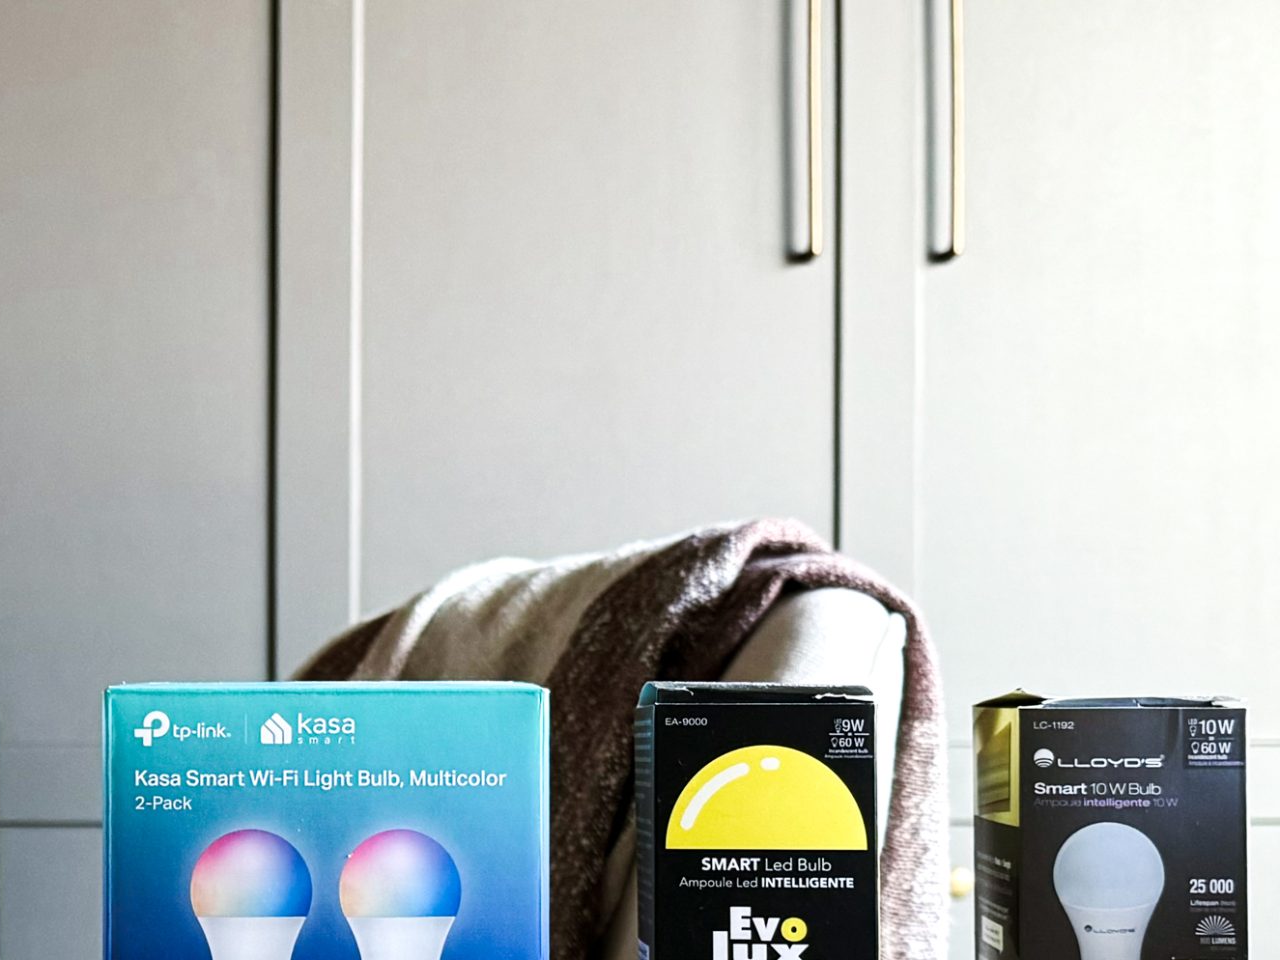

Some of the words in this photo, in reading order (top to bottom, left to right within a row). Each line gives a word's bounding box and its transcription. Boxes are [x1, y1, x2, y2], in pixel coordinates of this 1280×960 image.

[298, 713, 356, 734] kasa
[665, 718, 708, 726] EA-9000
[842, 719, 865, 732] 9W
[1033, 721, 1074, 729] LC-1192
[1199, 720, 1217, 734] 10
[1218, 720, 1234, 734] W
[298, 736, 356, 744] smart
[839, 738, 852, 748] 60
[854, 738, 865, 747] W
[1201, 742, 1216, 753] 60
[1219, 742, 1231, 753] W
[1057, 758, 1162, 768] LLOYD'S
[135, 770, 181, 787] Kasa
[186, 769, 245, 787] Smart
[249, 769, 299, 787] Wi-Fi
[304, 769, 353, 790] Light
[358, 770, 404, 788] Bulb,
[410, 770, 507, 787] Multicolor
[1034, 782, 1087, 795] Smart
[1090, 783, 1107, 795] 10
[1109, 783, 1126, 795] W
[1129, 783, 1161, 795] Bulb
[135, 796, 192, 811] 2-Pack
[1084, 798, 1150, 808] intelligente
[701, 857, 760, 871] SMART
[765, 858, 792, 871] Led
[798, 858, 832, 871] Bulb
[679, 877, 733, 889] Ampoule
[737, 877, 758, 887] Led
[761, 877, 854, 888] INTELLIGENTE
[1190, 879, 1206, 893] 25
[1210, 879, 1234, 893] 000
[730, 906, 807, 942] Evo
